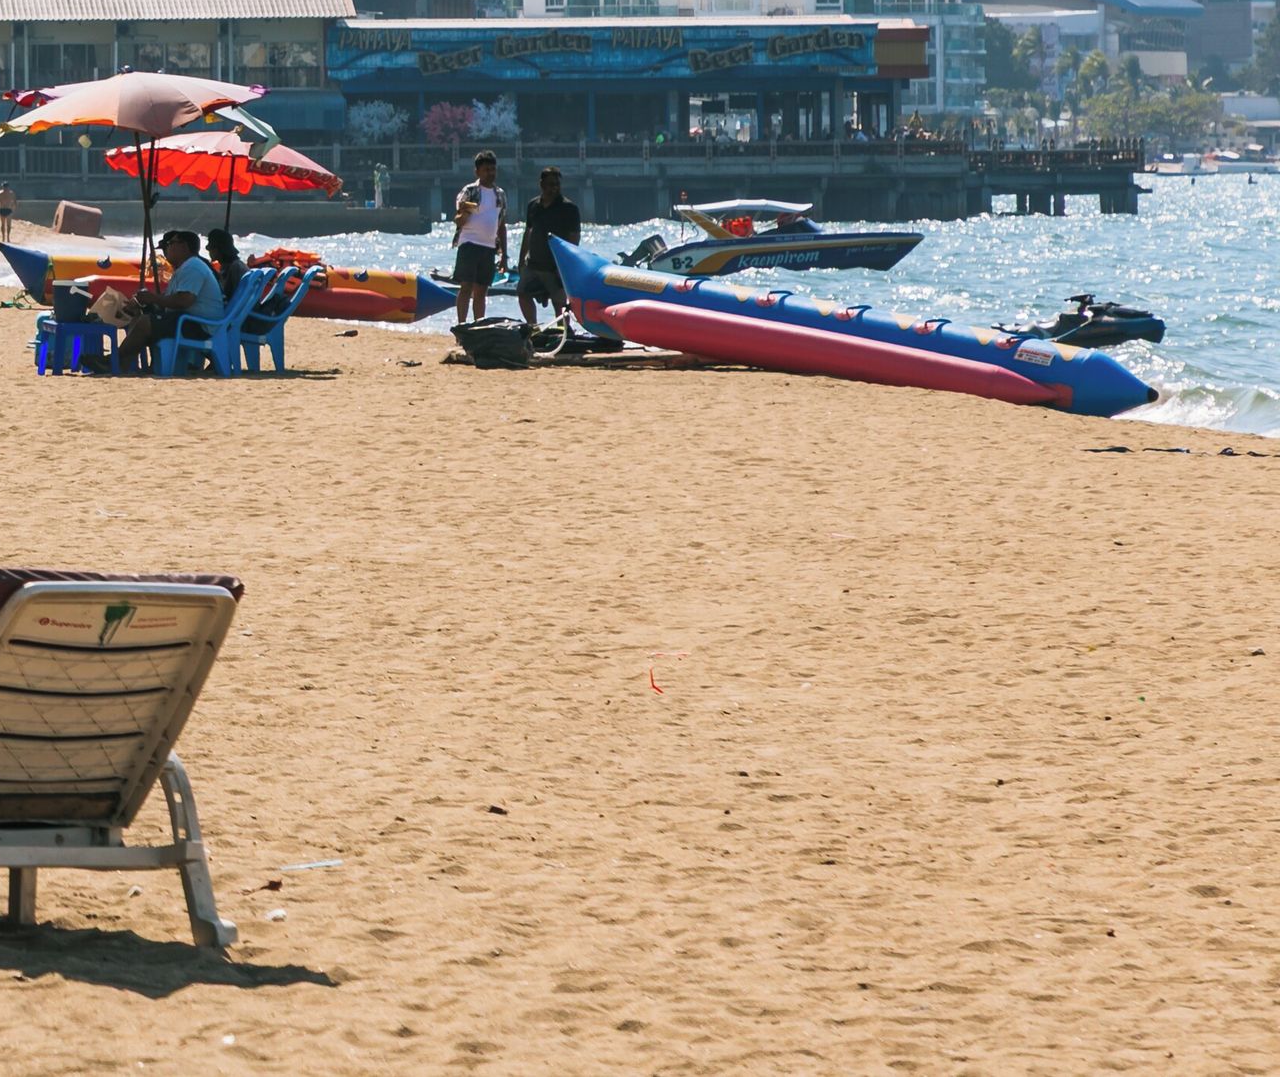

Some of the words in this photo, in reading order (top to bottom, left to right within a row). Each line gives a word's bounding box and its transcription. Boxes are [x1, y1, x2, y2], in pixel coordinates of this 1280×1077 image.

[339, 28, 412, 52] PATTAYA
[418, 44, 483, 75] Beer
[495, 29, 592, 59] Garden
[611, 26, 683, 51] PATTAYA
[690, 42, 754, 73] Beer
[766, 26, 865, 60] Garden
[672, 256, 693, 270] B-2
